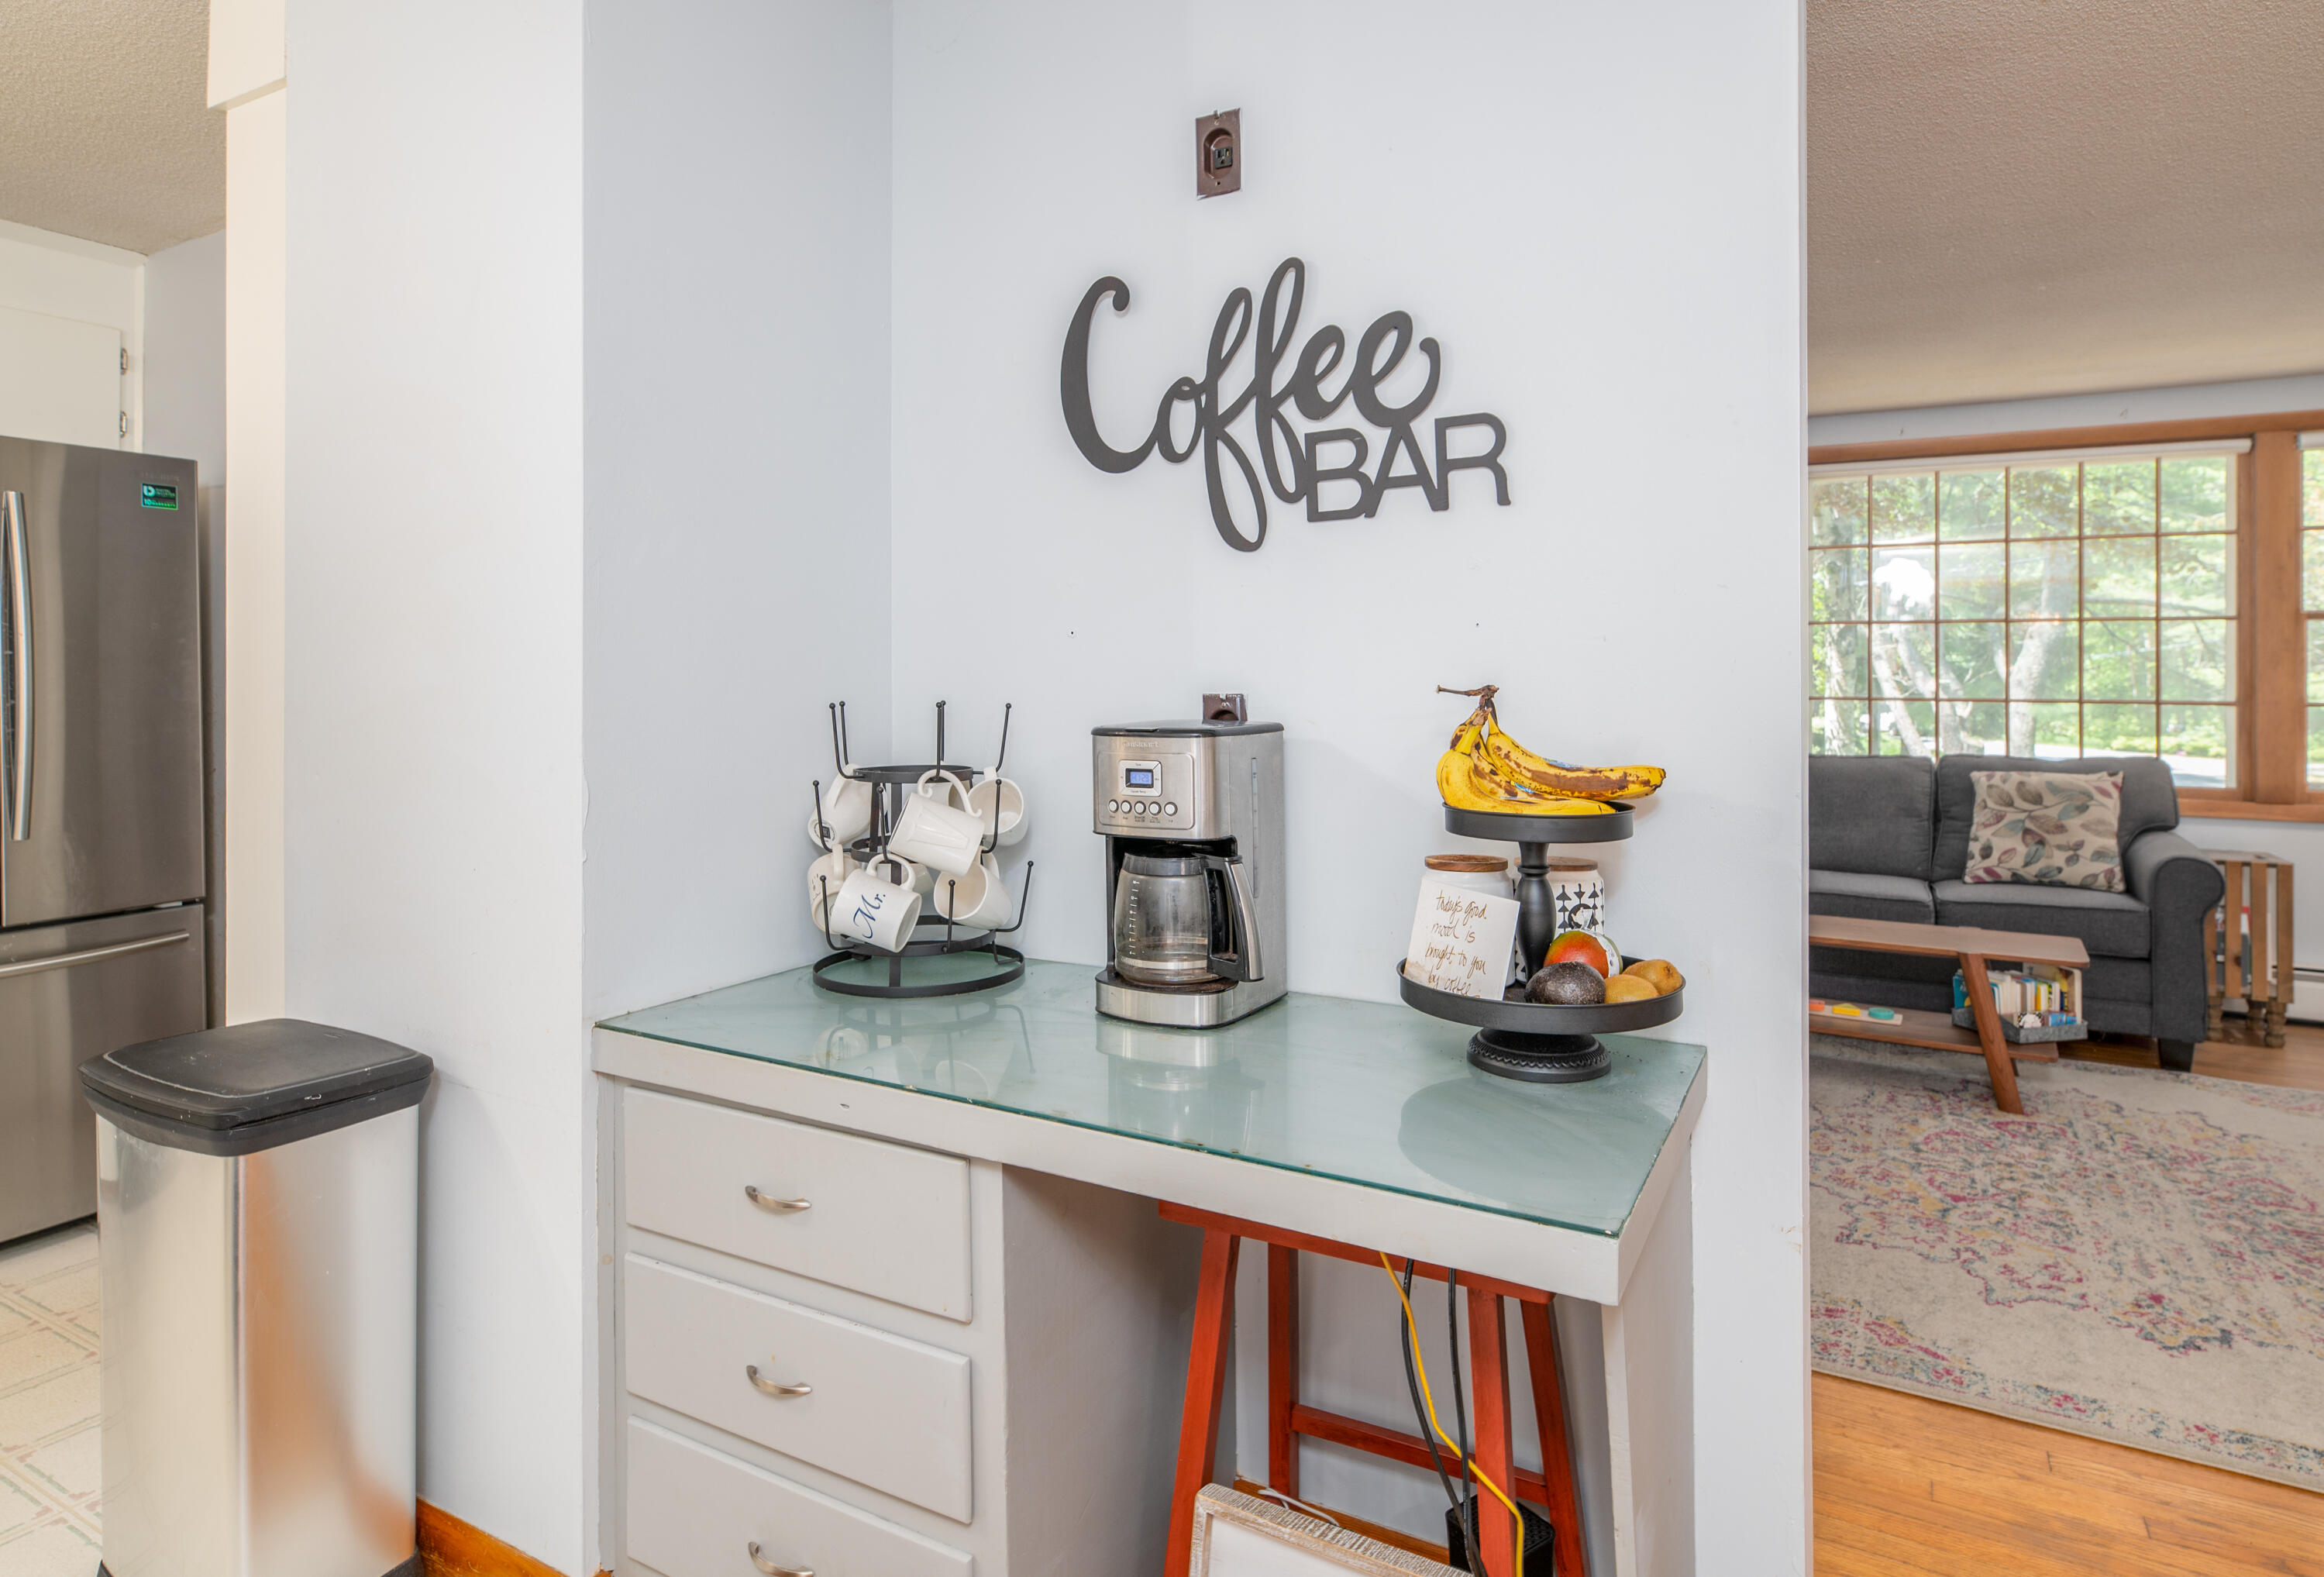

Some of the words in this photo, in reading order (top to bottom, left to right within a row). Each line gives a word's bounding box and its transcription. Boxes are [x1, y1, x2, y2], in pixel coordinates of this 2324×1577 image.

[1061, 257, 1441, 552] Coffee
[1305, 412, 1511, 522] BAR
[853, 894, 886, 938] Mr.
[1436, 889, 1462, 924] today's
[1431, 918, 1459, 938] mood
[1465, 925, 1475, 943] is
[1458, 949, 1467, 967] to
[1467, 955, 1486, 980] you
